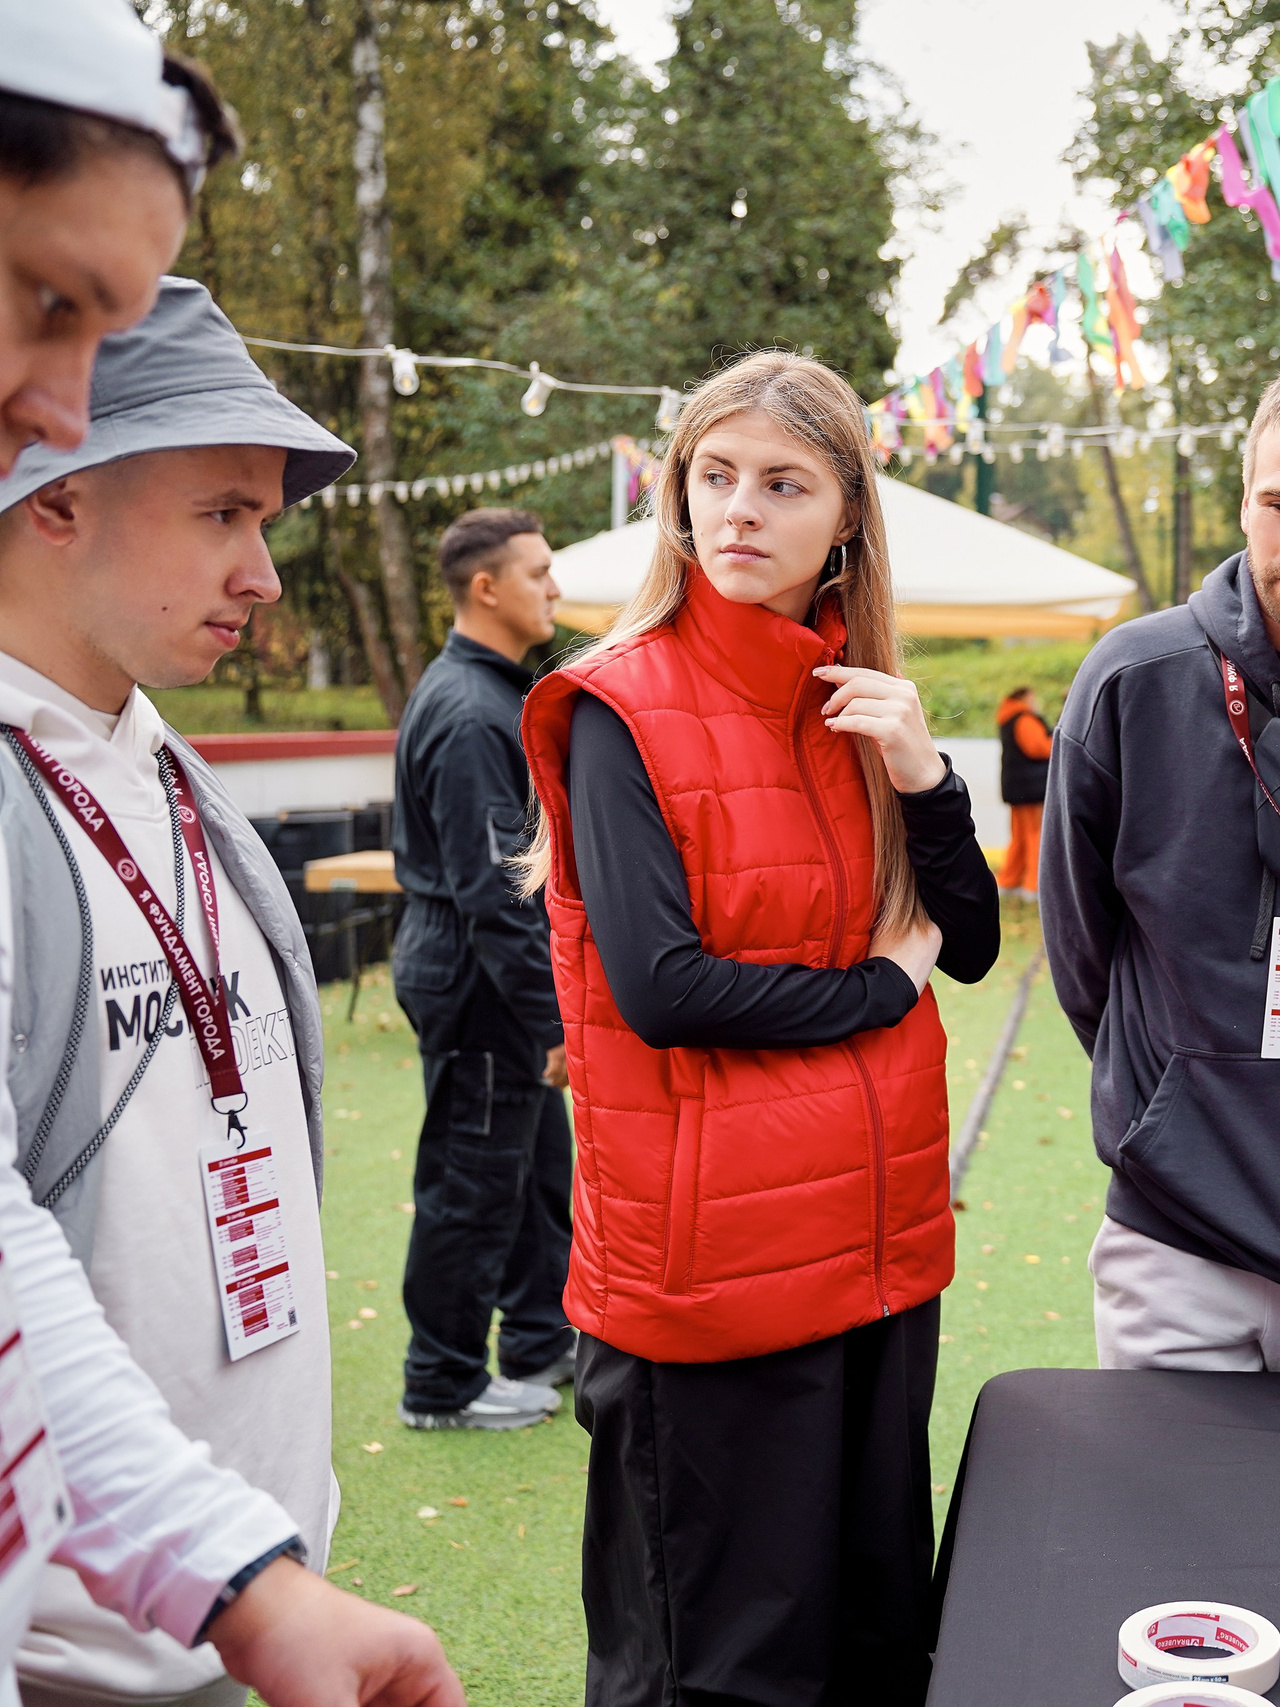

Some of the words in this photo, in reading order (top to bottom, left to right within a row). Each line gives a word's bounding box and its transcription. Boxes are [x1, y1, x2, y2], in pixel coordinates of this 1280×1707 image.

[51, 763, 105, 832] ГОРОДА
[194, 851, 216, 912] ГОРОДА
[139, 889, 152, 903] Я
[149, 902, 203, 997] ФУНДАМЕНТ
[194, 996, 226, 1061] ГОРОДА
